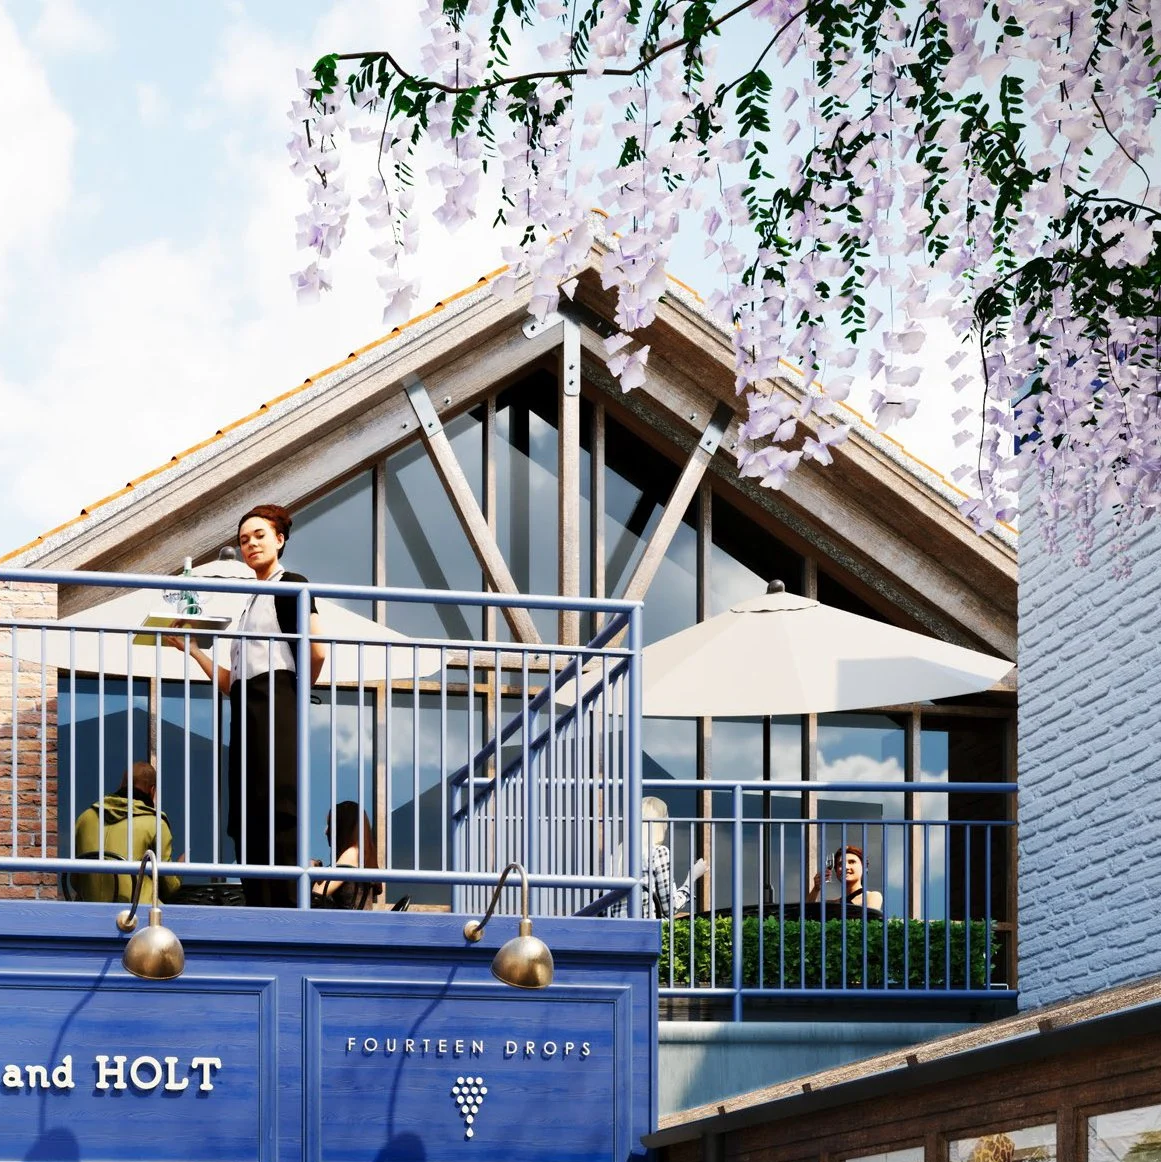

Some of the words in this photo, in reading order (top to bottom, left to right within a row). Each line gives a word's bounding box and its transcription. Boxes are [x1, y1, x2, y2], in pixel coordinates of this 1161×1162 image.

[347, 1037, 484, 1054] FOURTEEN
[506, 1041, 591, 1056] DROPS
[2, 1055, 76, 1089] and
[95, 1055, 222, 1091] HOLT
